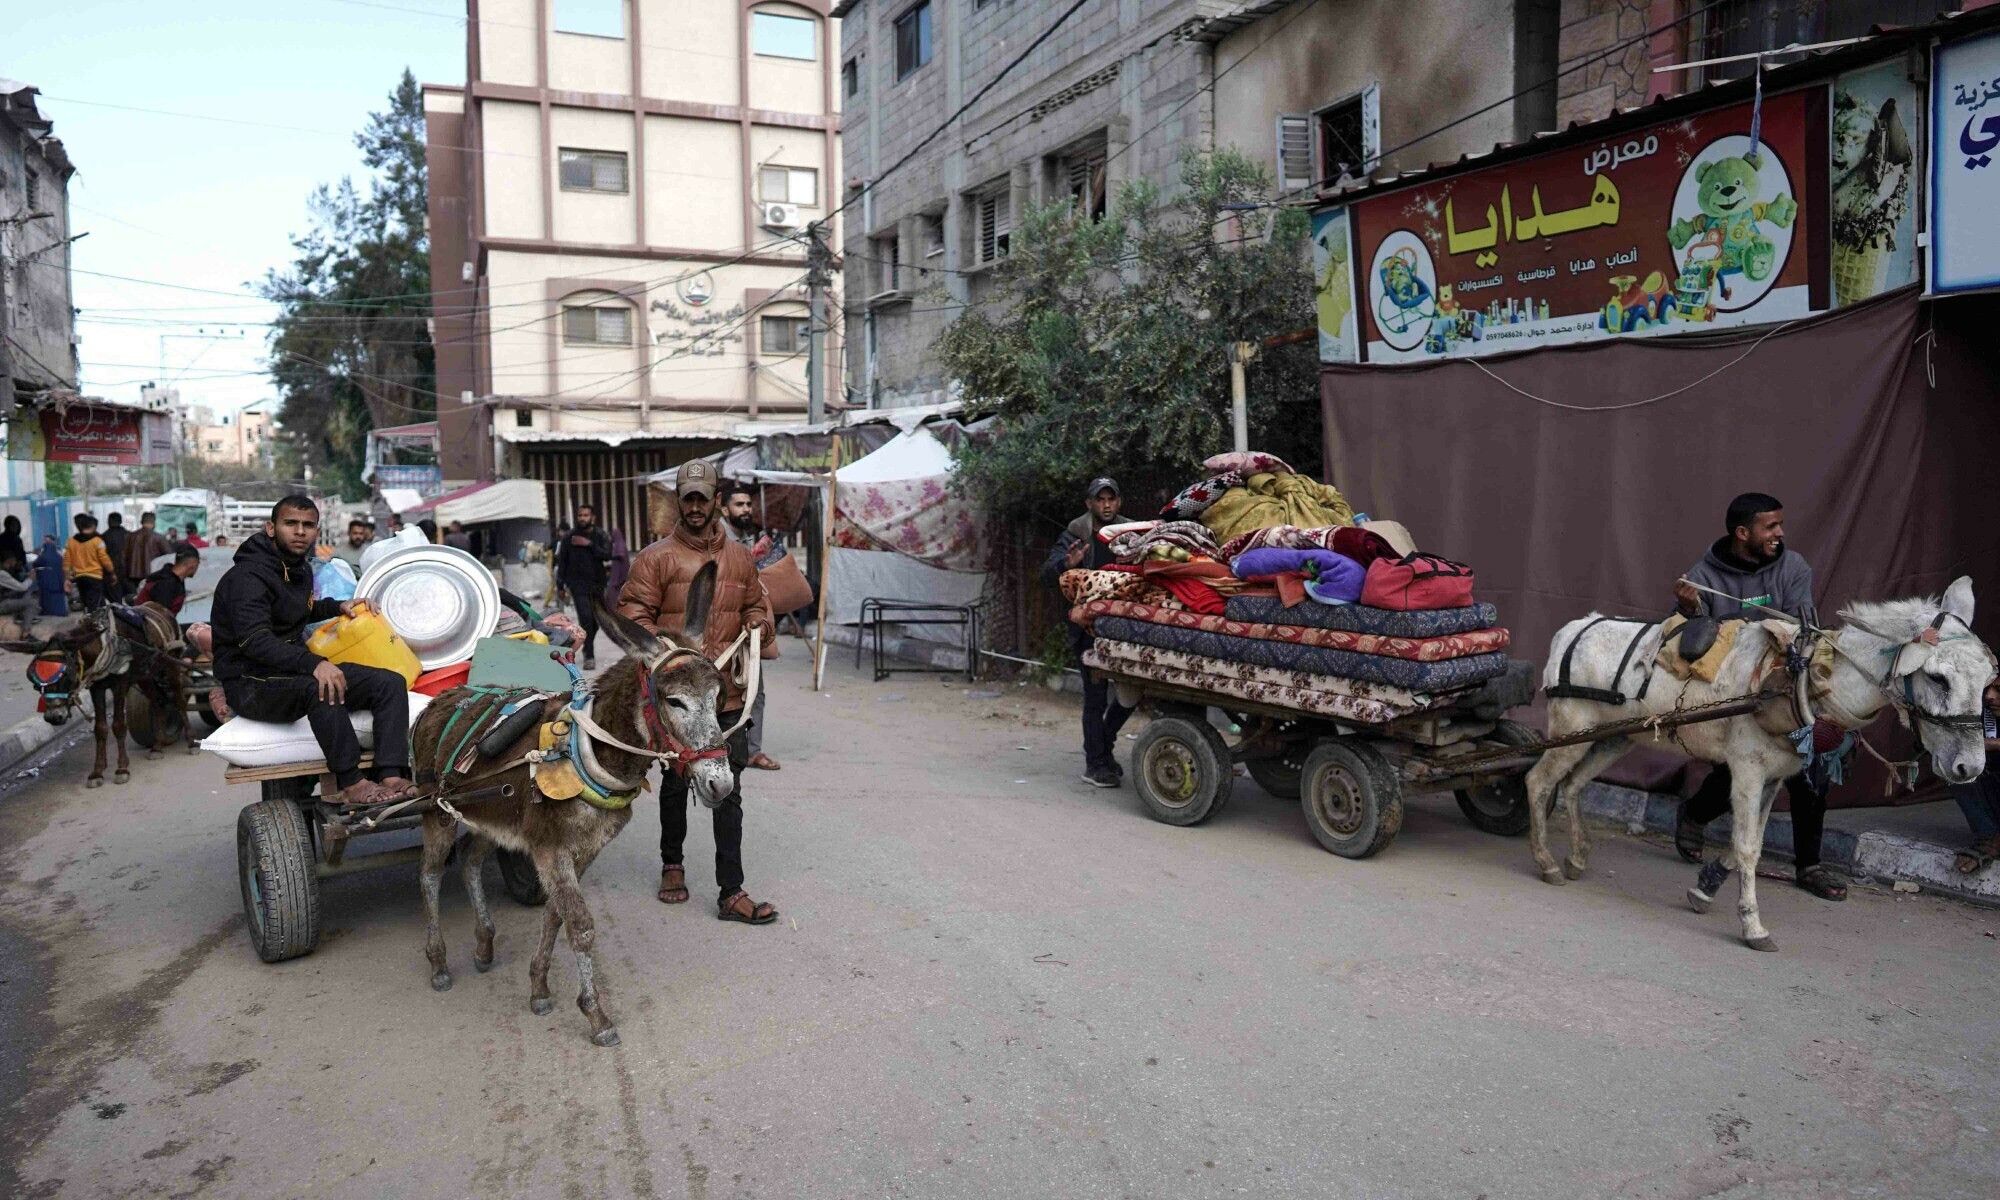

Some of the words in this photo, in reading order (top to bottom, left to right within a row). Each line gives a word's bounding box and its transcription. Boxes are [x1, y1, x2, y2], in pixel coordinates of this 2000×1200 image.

[1583, 135, 1659, 176] معرض
[1445, 173, 1621, 269] هدايا
[1606, 246, 1638, 269] ألعاب
[1517, 266, 1556, 283] قرطاسية
[1569, 258, 1596, 275] هدايا
[1458, 275, 1503, 292] اكسسوارات
[1550, 326, 1572, 334] محمد
